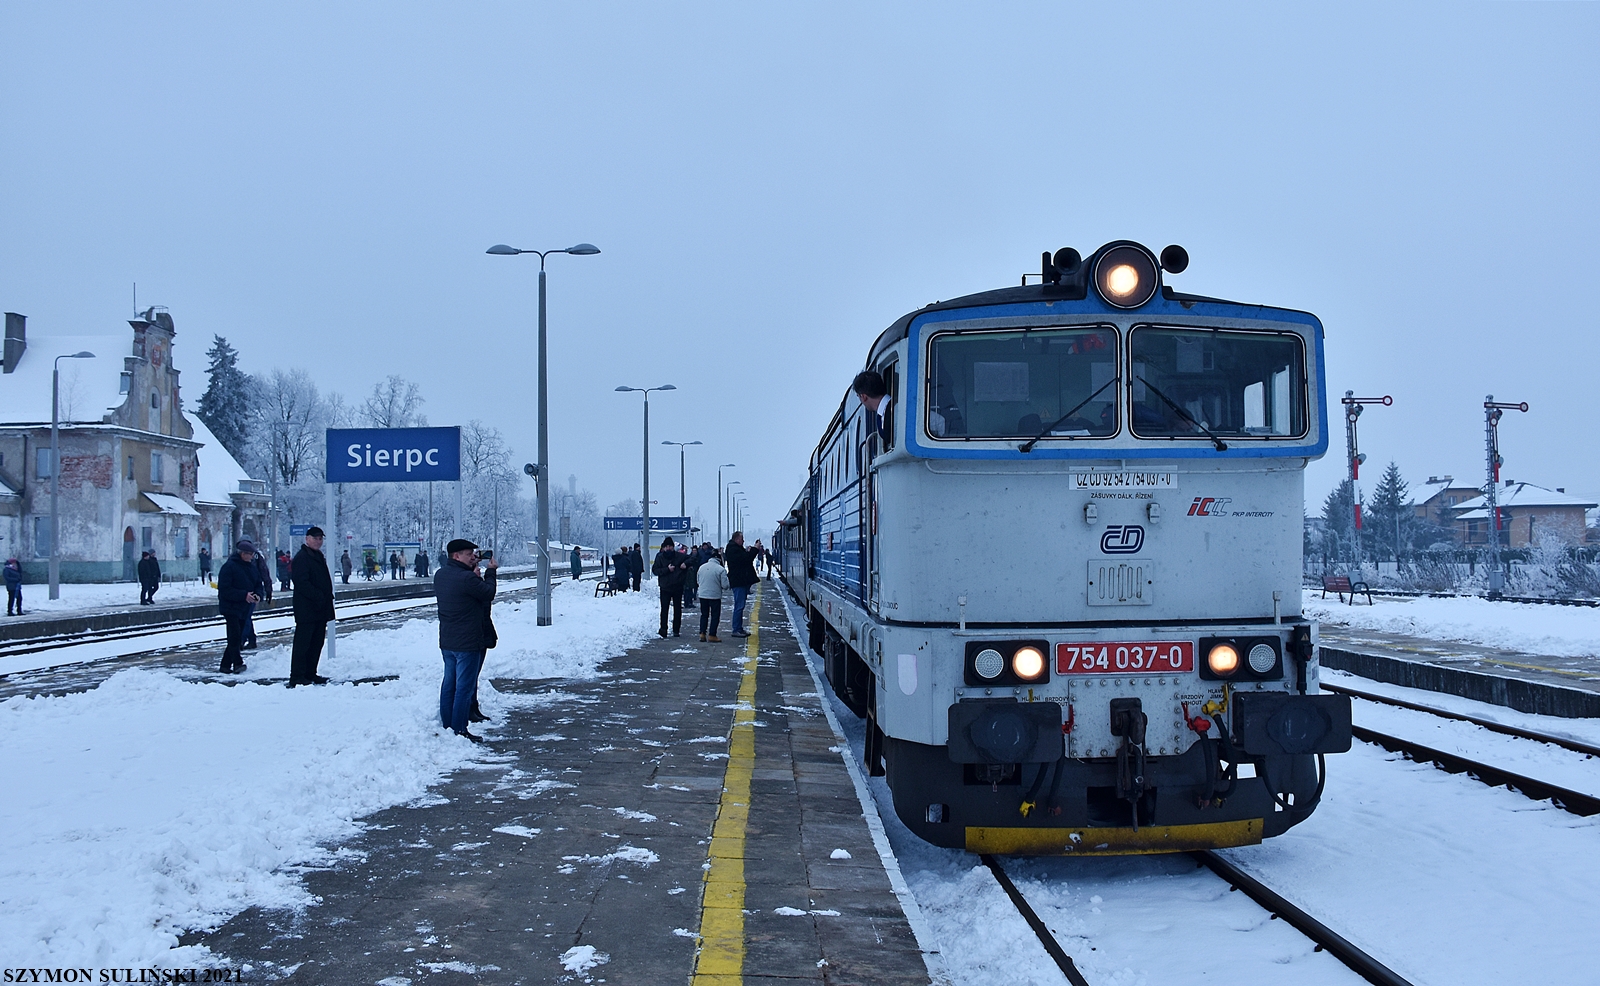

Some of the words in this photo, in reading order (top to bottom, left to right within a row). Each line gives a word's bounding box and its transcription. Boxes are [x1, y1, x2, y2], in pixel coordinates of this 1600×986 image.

[347, 443, 439, 473] Sierpc
[1076, 473, 1088, 487] CZ
[1103, 473, 1113, 487] 92
[1114, 473, 1123, 487] 54
[1125, 472, 1130, 486] 2
[606, 520, 615, 529] 11
[651, 518, 659, 529] 2
[682, 520, 688, 529] 5
[1066, 646, 1110, 671] 754
[1115, 645, 1183, 669] 037-0
